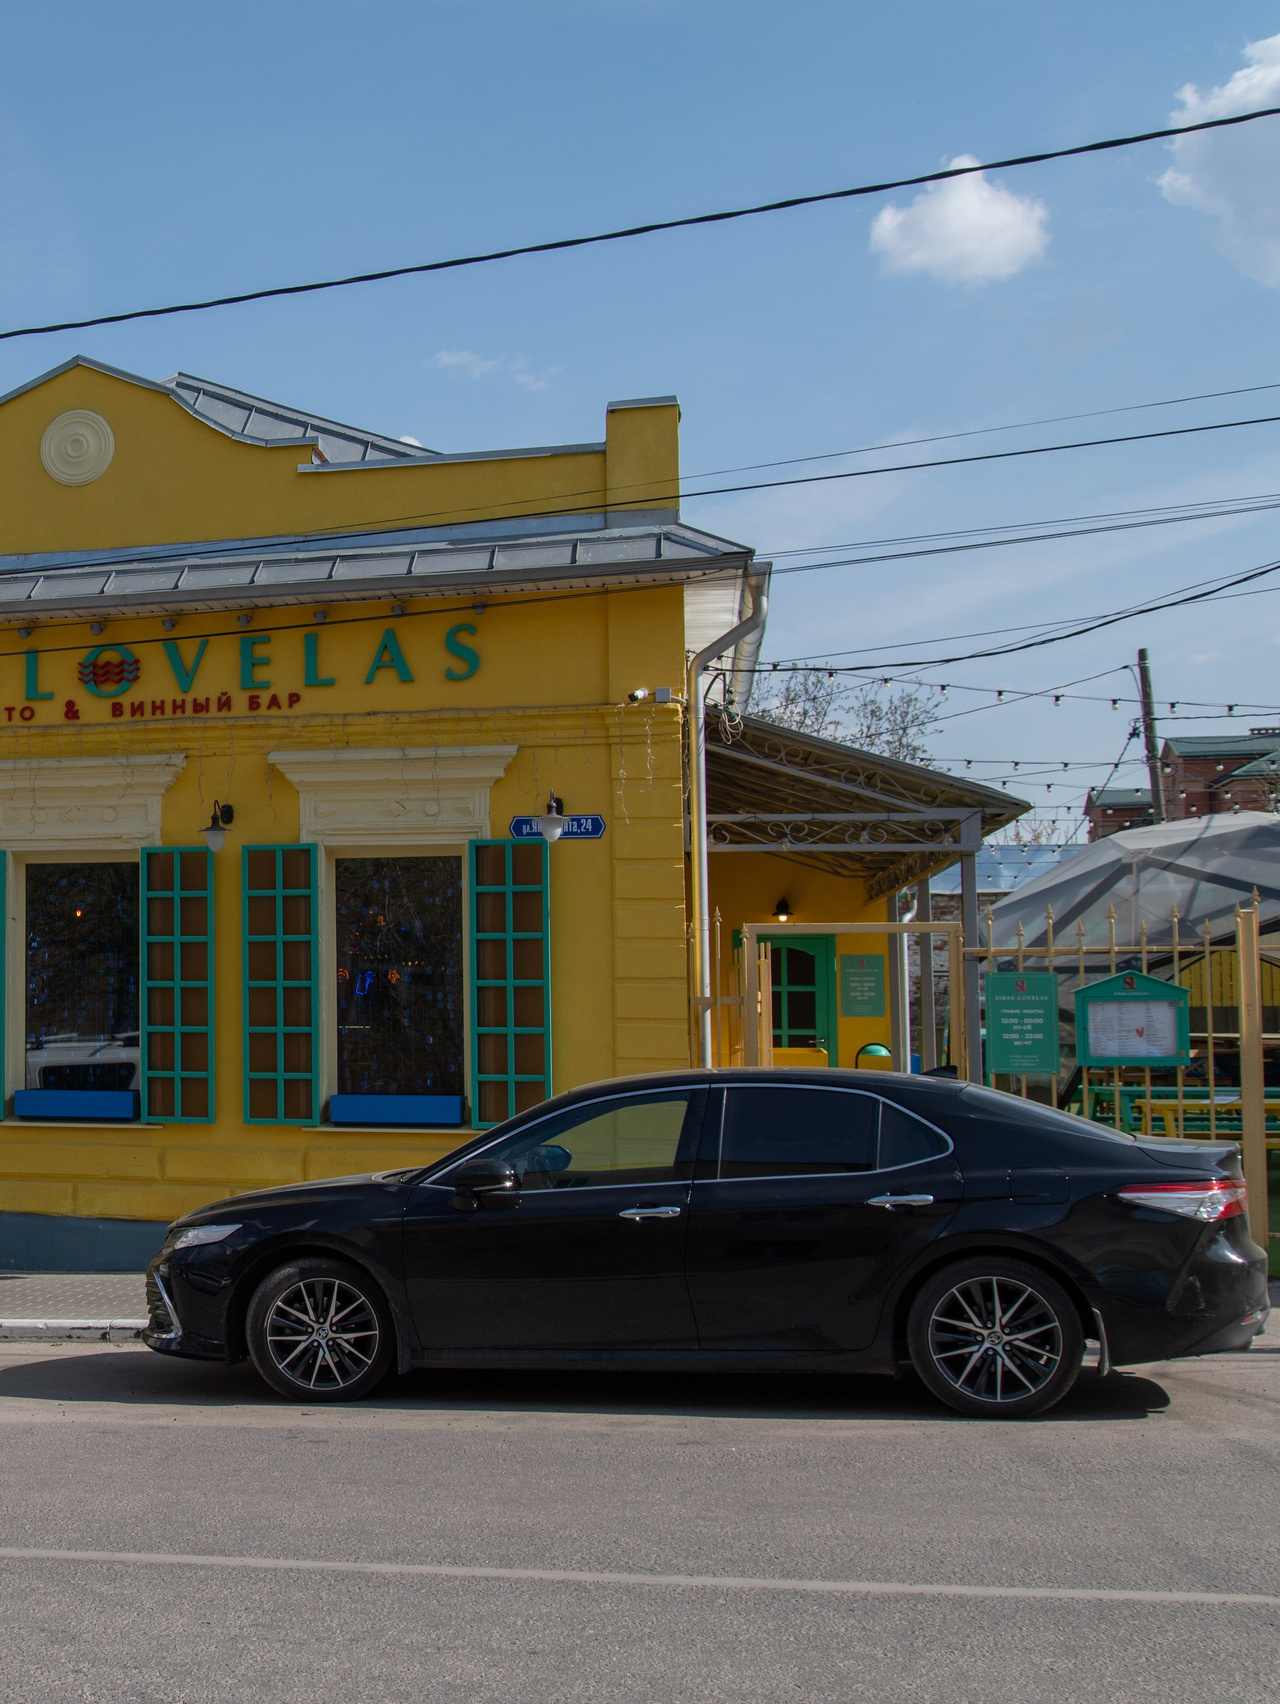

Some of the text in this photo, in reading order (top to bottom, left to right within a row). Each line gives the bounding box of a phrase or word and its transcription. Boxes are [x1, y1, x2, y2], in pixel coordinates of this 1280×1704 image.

[63, 699, 81, 721] &
[111, 692, 232, 719] ВИННЫЙ
[247, 691, 302, 713] БАР
